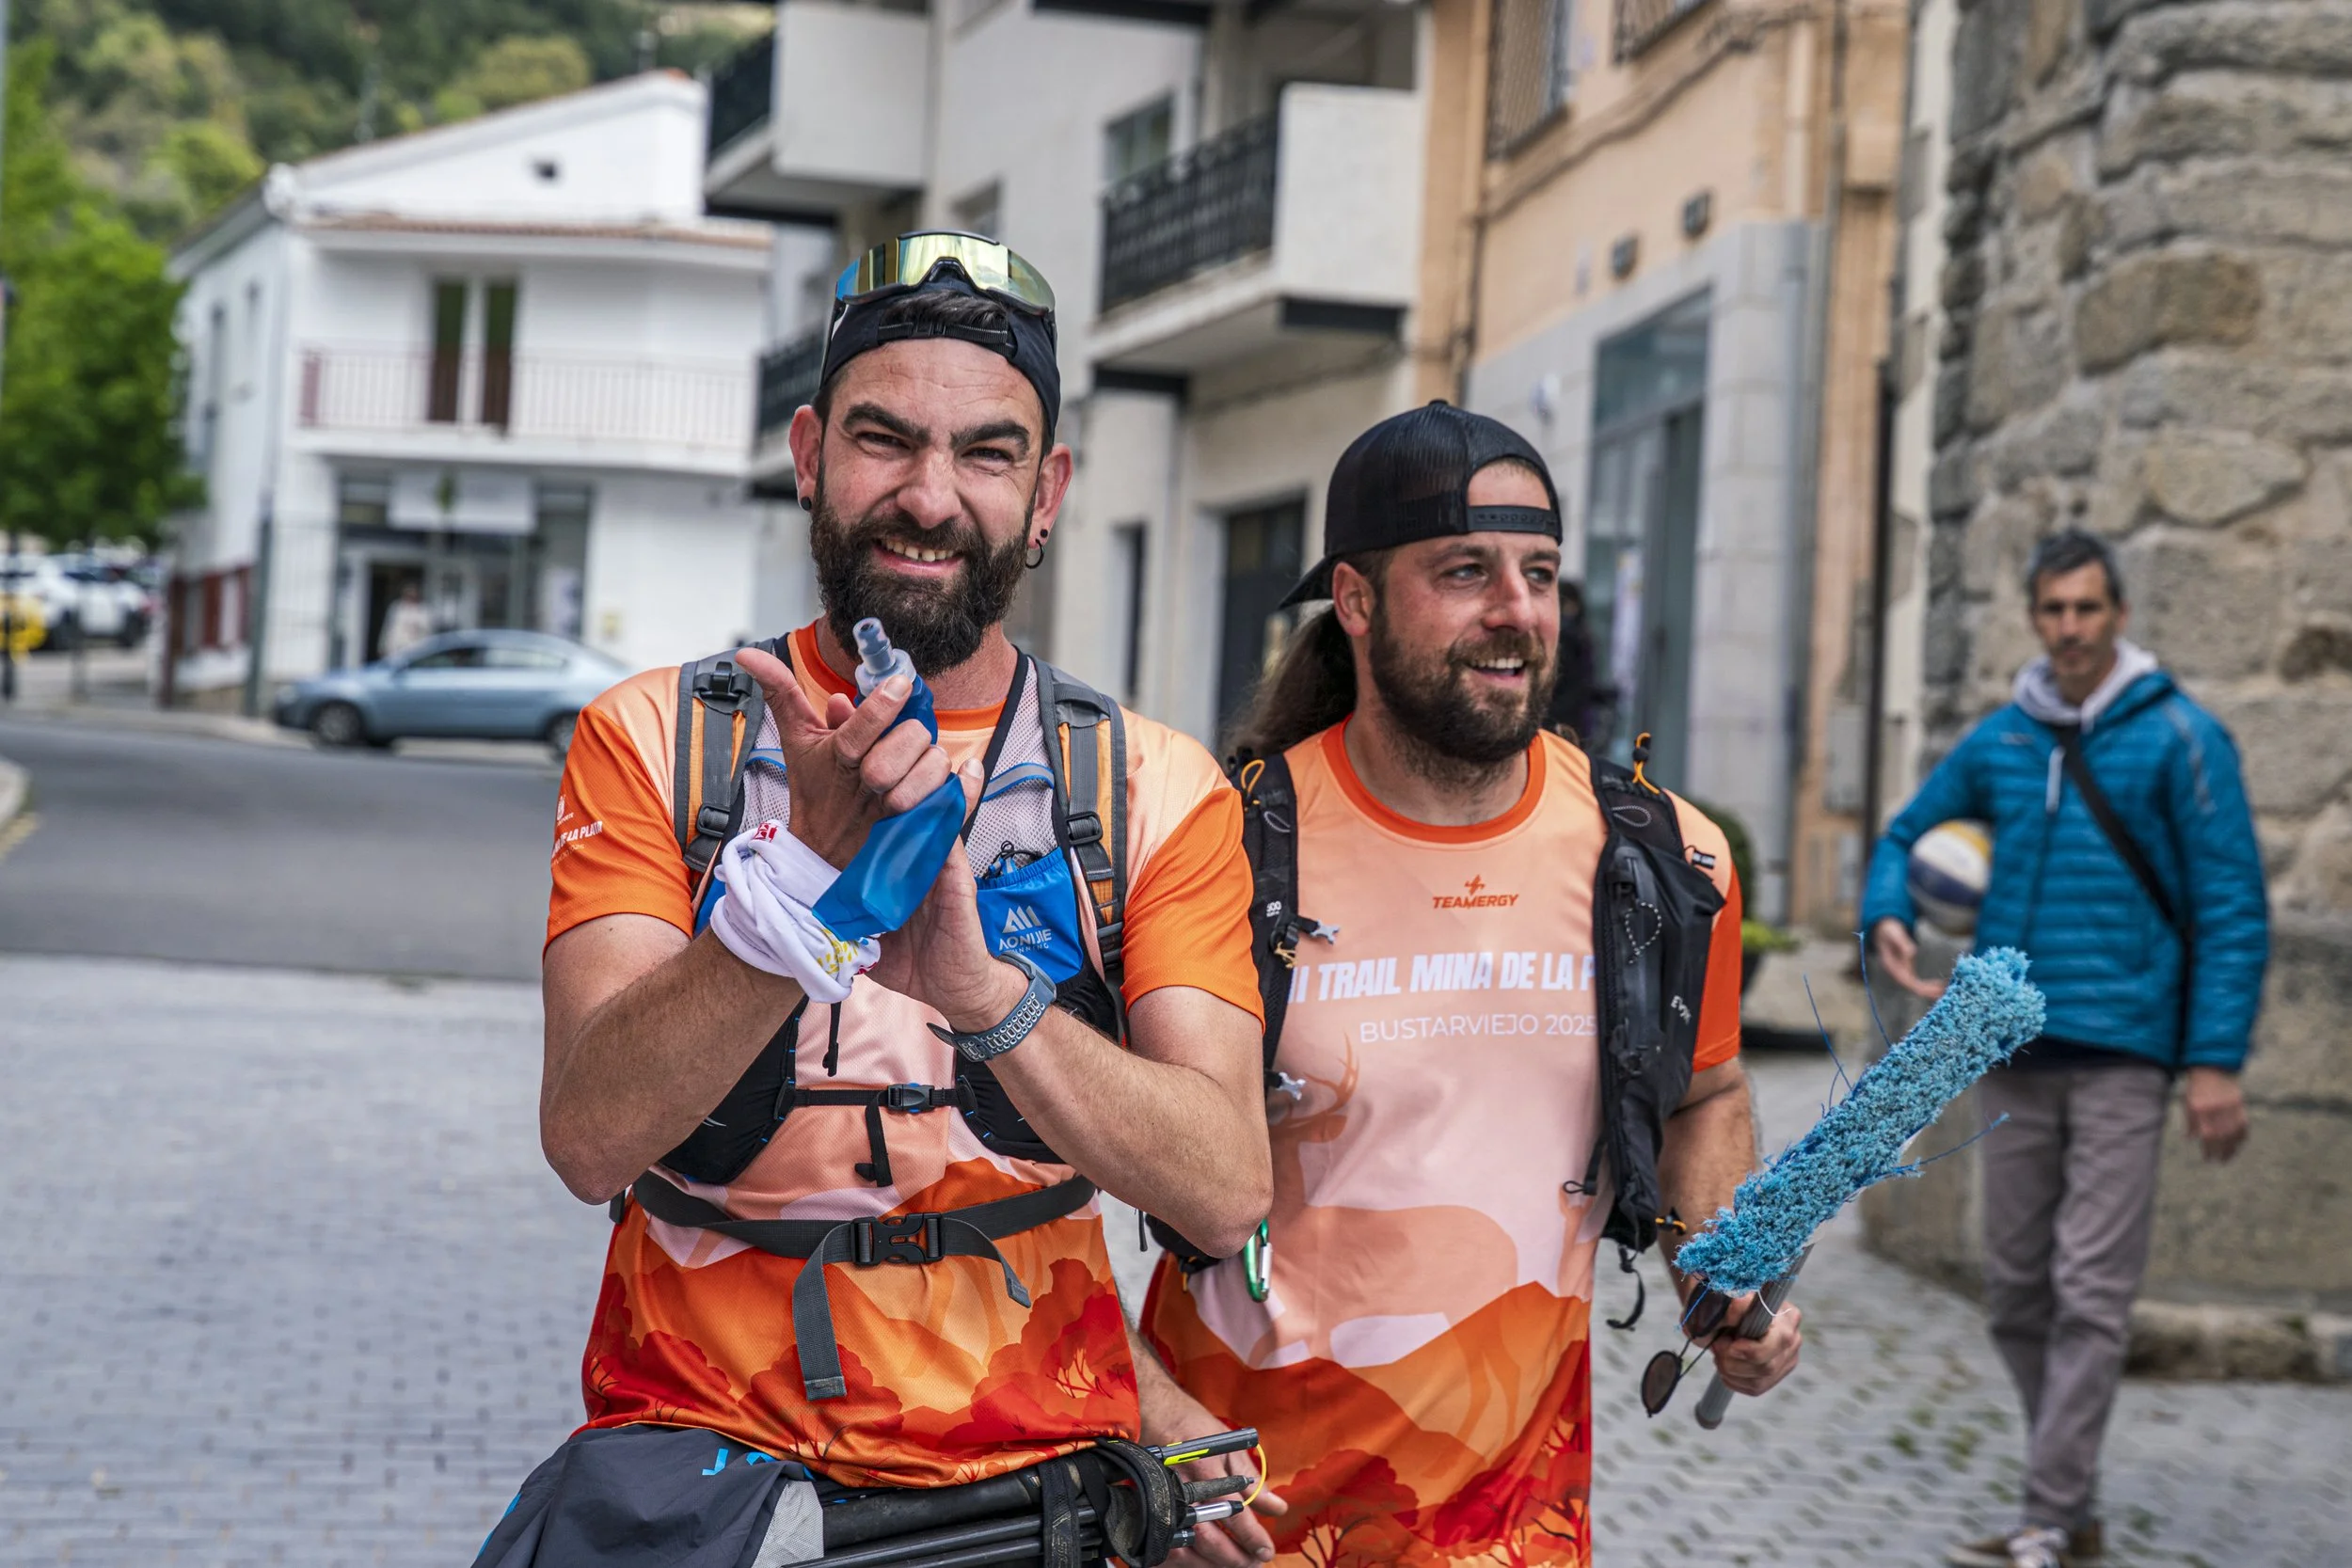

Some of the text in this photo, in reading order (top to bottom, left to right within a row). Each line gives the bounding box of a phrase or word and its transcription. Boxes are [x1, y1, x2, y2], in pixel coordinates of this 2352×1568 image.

[1432, 894, 1519, 909] TEAMERGY
[1317, 958, 1401, 1001] TRAIL
[1409, 952, 1493, 992] MINA
[1499, 952, 1535, 990] DE
[1541, 953, 1573, 990] LA
[1360, 1013, 1598, 1043] BUSTARVIEJO 2025
